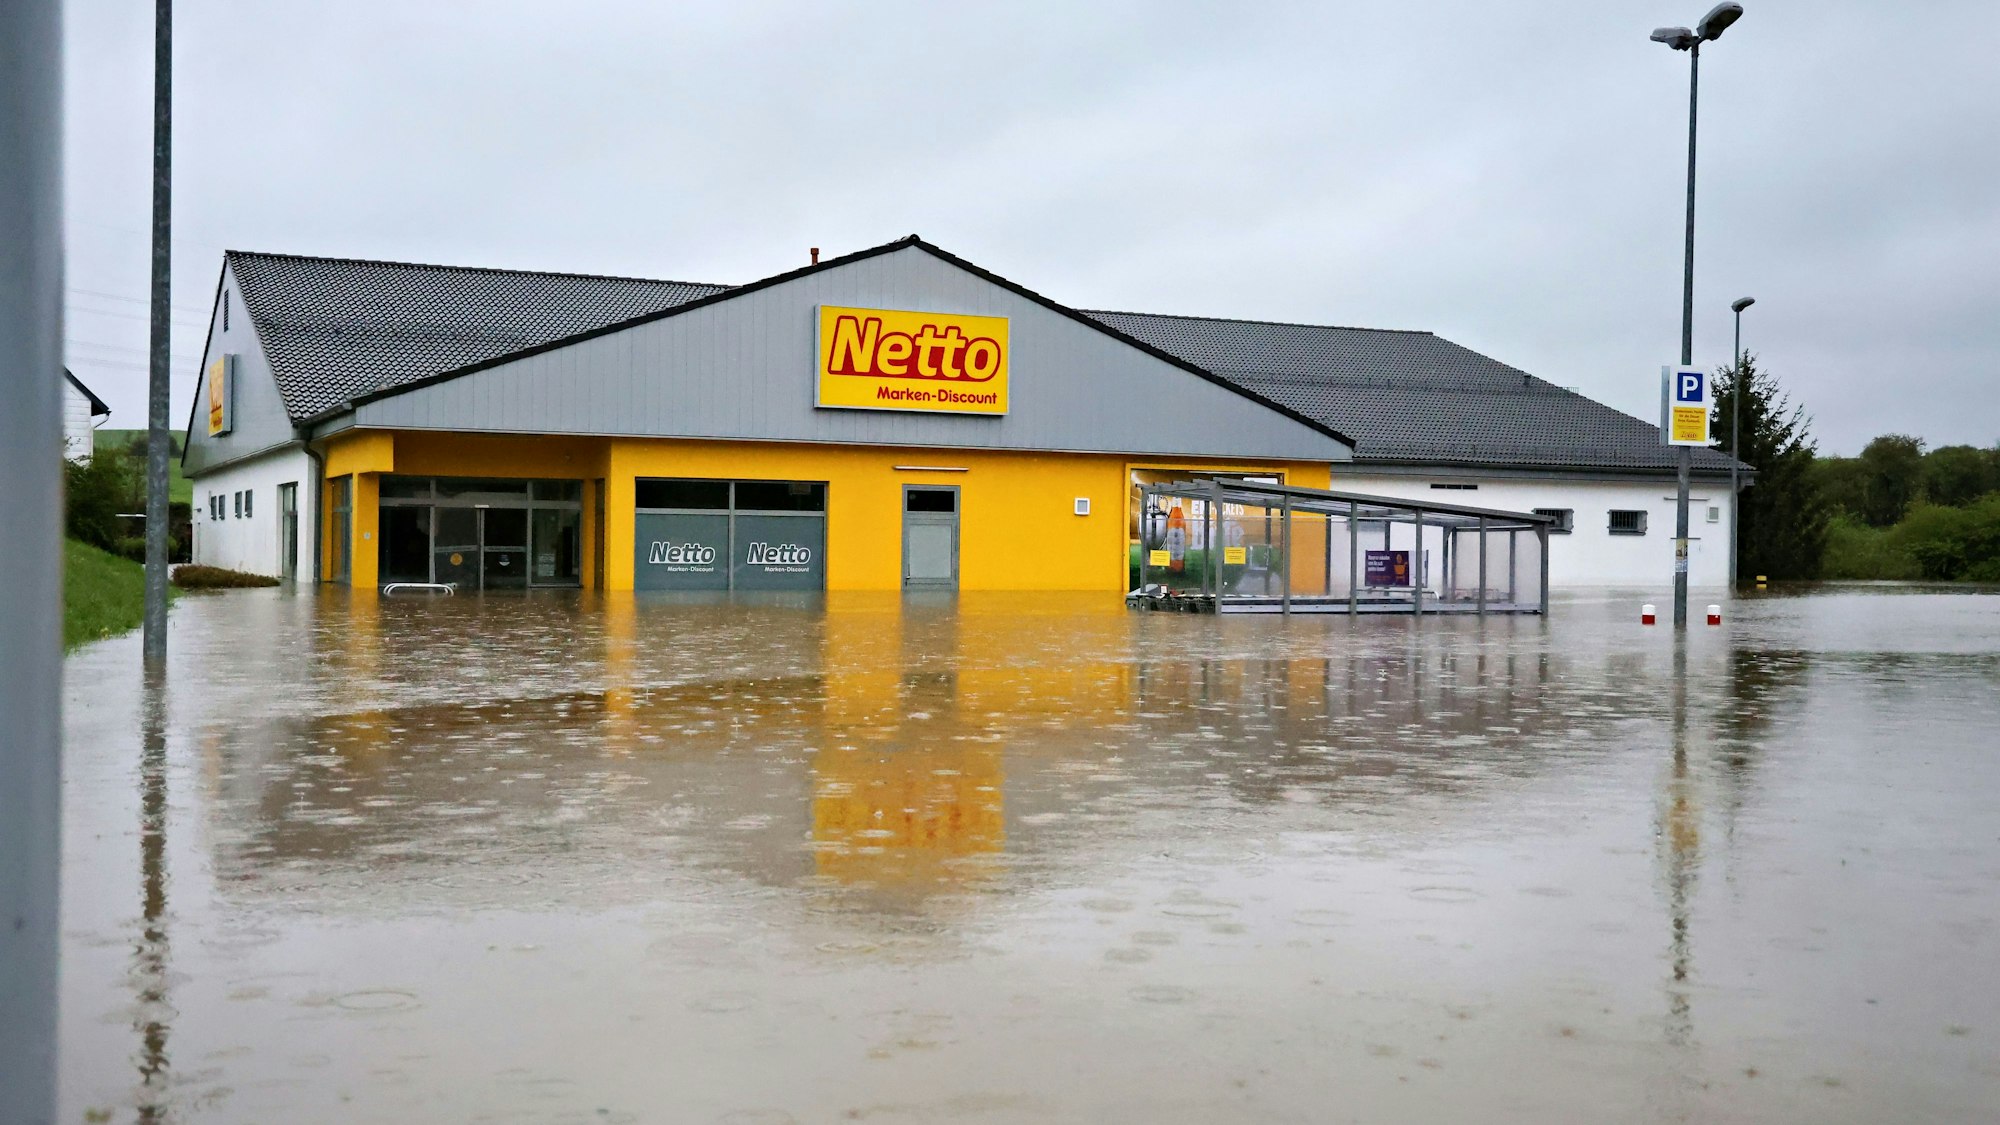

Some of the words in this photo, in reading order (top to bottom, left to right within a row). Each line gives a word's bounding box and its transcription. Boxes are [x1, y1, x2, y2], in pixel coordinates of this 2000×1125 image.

[828, 315, 1001, 382] Netto
[877, 386, 998, 405] Marken-Discount
[1682, 376, 1698, 398] P
[649, 541, 716, 565] Netto
[747, 542, 811, 565] Netto
